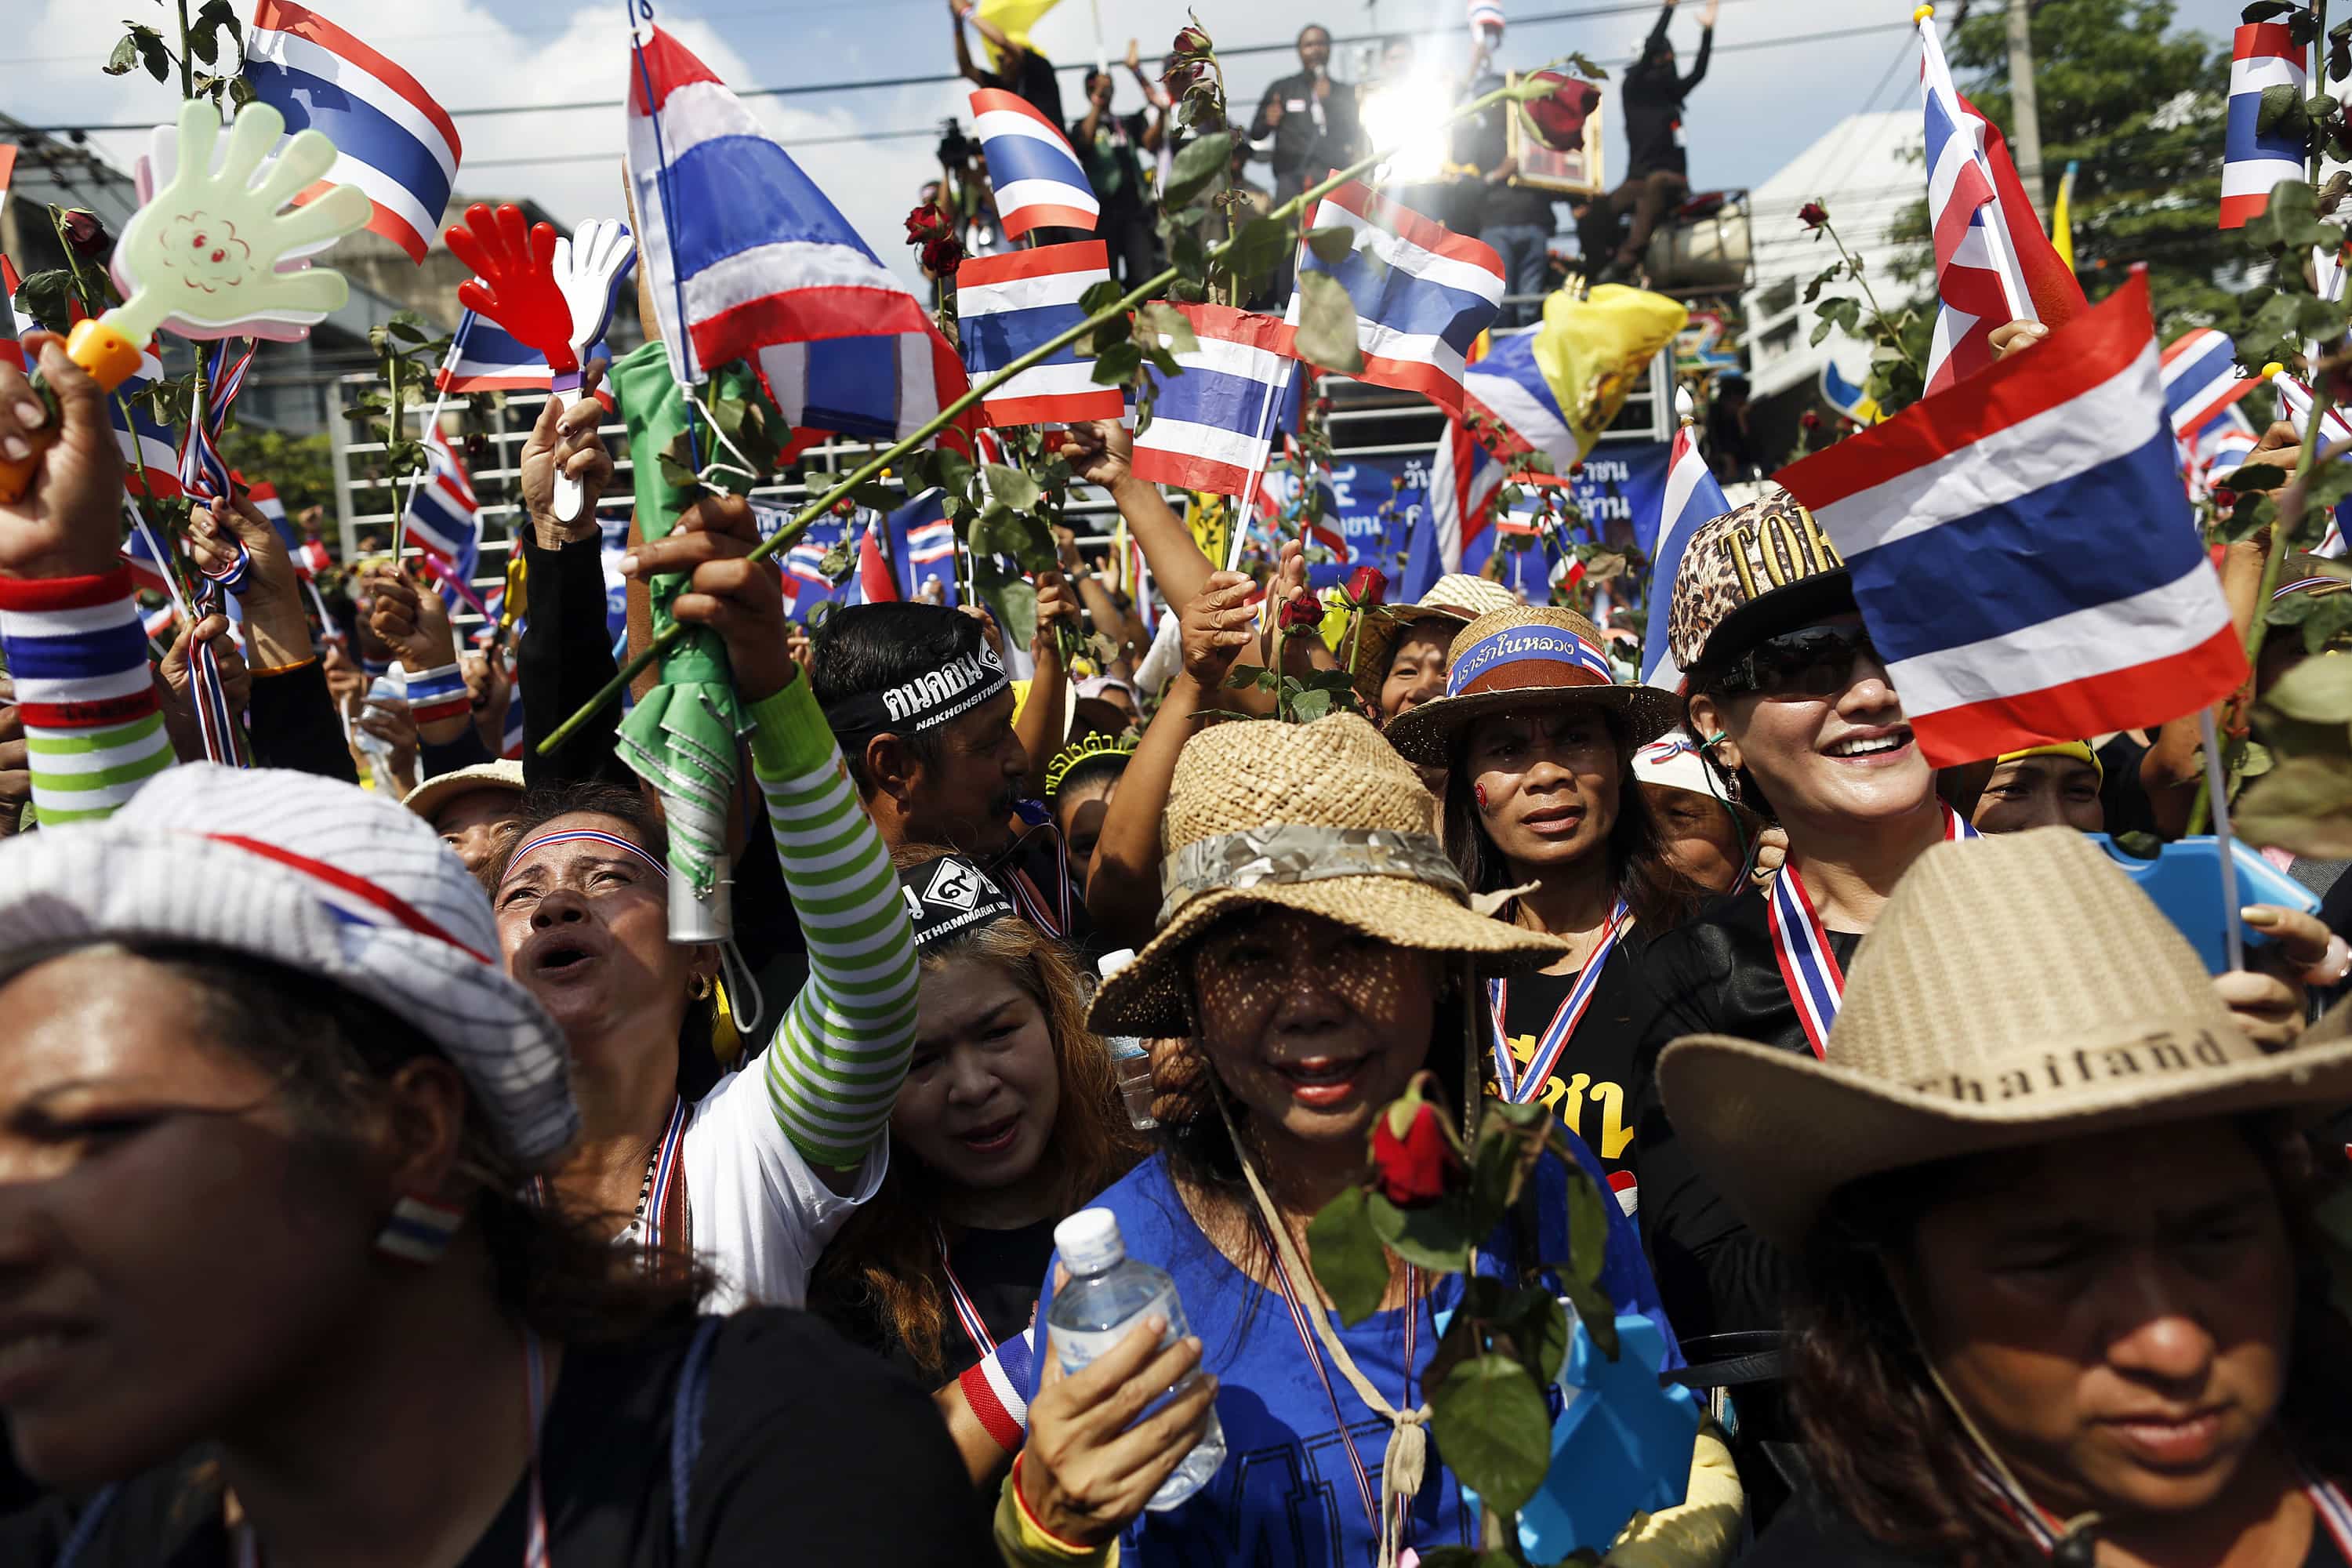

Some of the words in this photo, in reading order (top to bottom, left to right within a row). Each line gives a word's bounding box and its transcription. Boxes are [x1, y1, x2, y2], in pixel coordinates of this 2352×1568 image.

[1457, 633, 1575, 685] เรารักในหลวง
